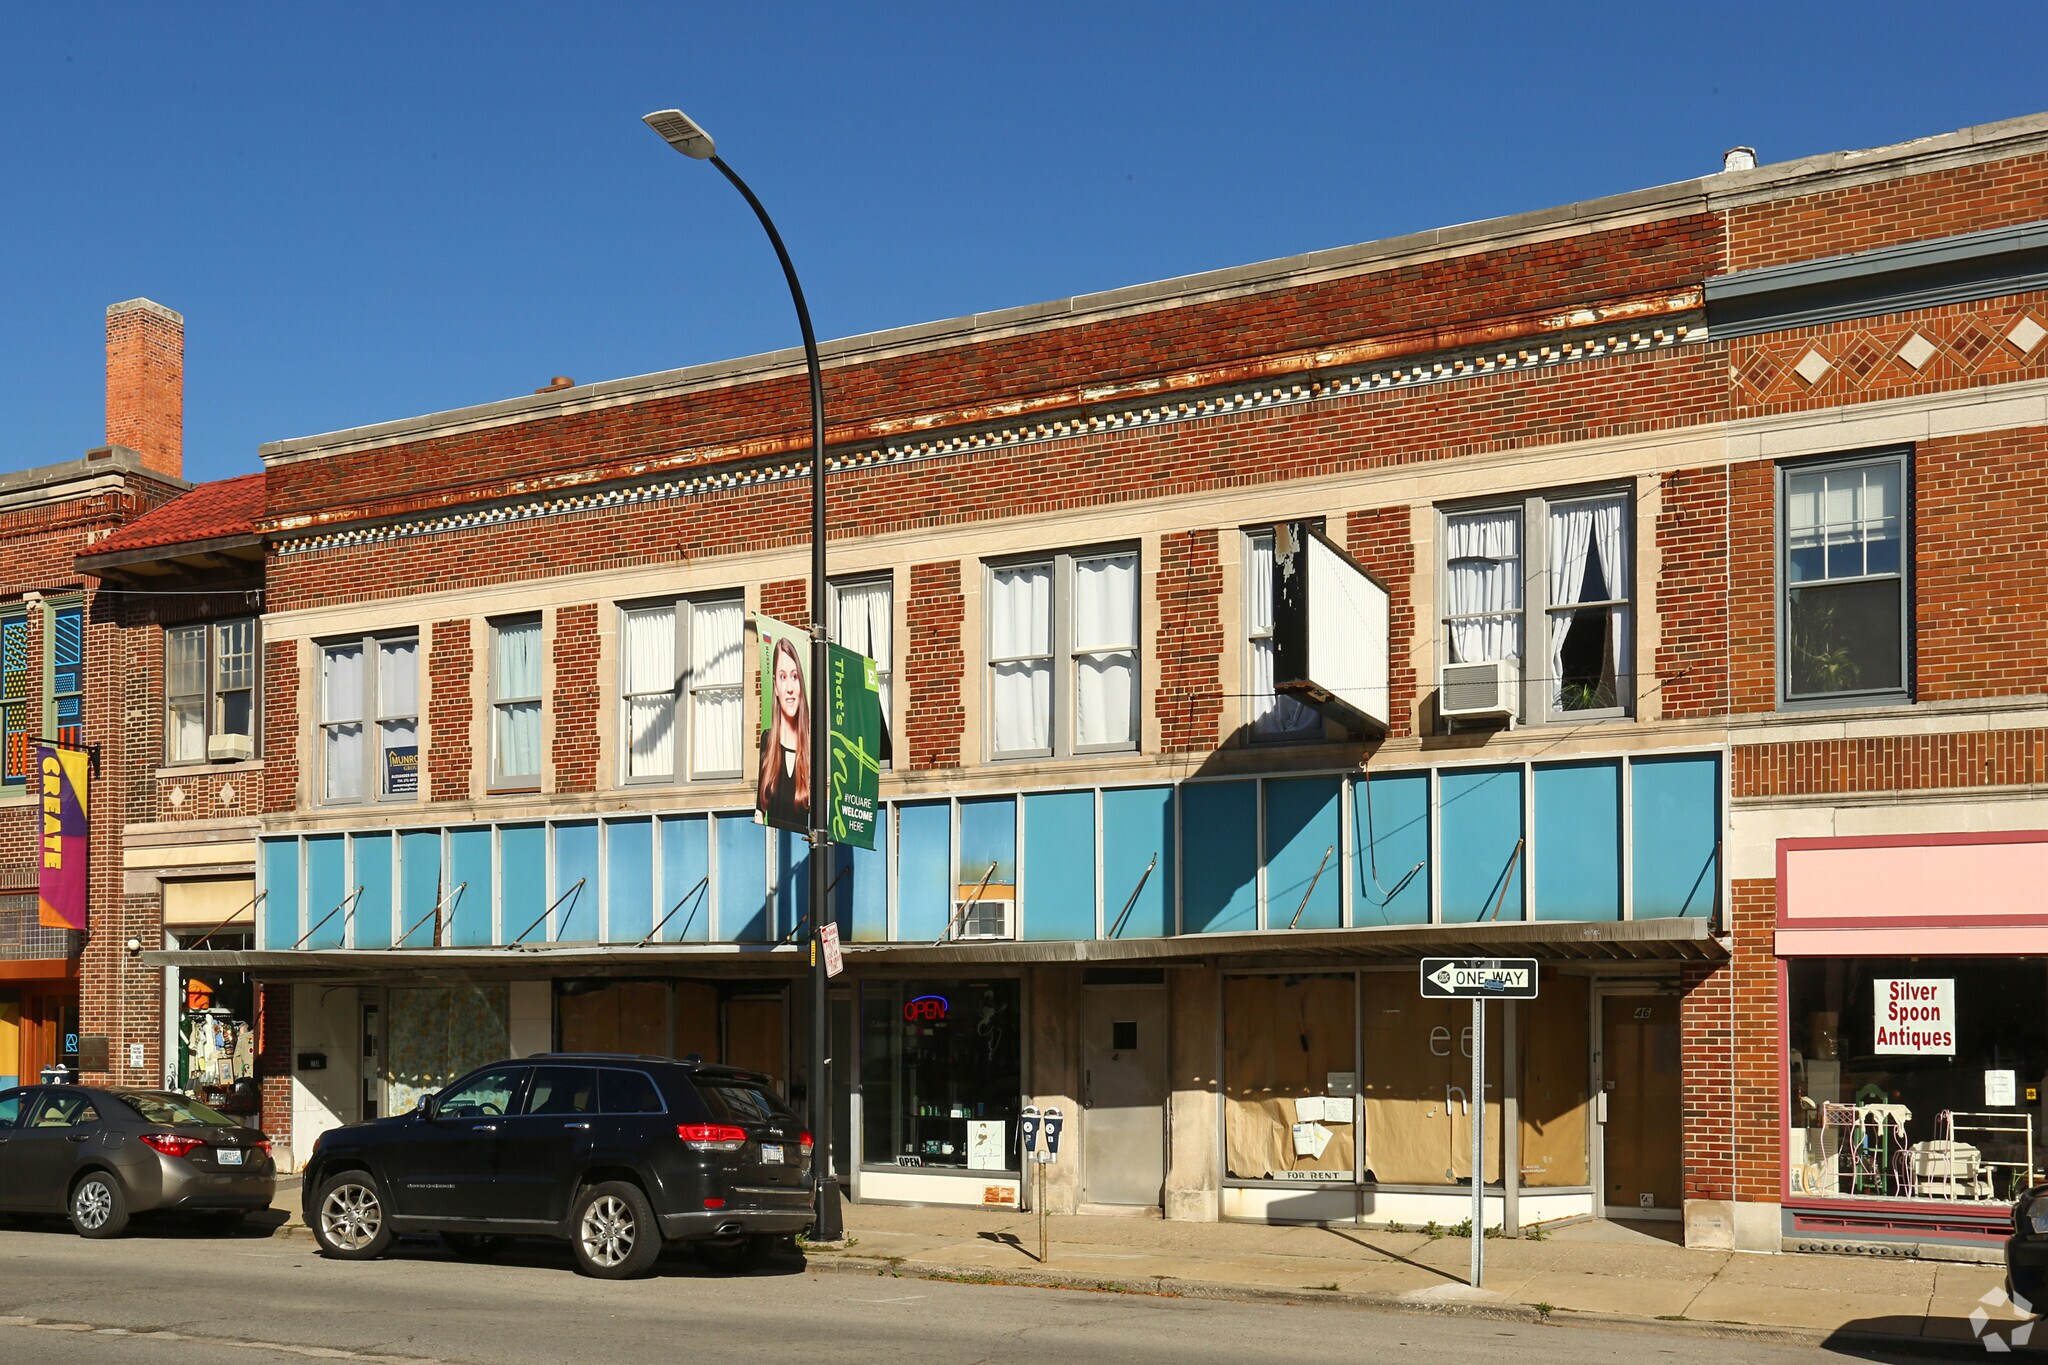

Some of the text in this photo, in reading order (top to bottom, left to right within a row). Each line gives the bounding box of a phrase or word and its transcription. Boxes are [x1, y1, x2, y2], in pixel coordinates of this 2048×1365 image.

[867, 669, 876, 685] E
[835, 658, 845, 726] That's
[844, 793, 872, 809] #YOUARE
[42, 757, 62, 870] CREATE
[842, 805, 873, 822] WELCOME
[849, 820, 864, 833] HERE
[1456, 971, 1523, 985] ONE WAY
[1889, 981, 1937, 1000] Silver
[904, 1001, 945, 1020] OPEN
[1635, 1008, 1651, 1019] 46
[1888, 1001, 1940, 1026] Spoon
[1877, 1026, 1952, 1051] Antiques
[898, 1157, 921, 1167] OPEN
